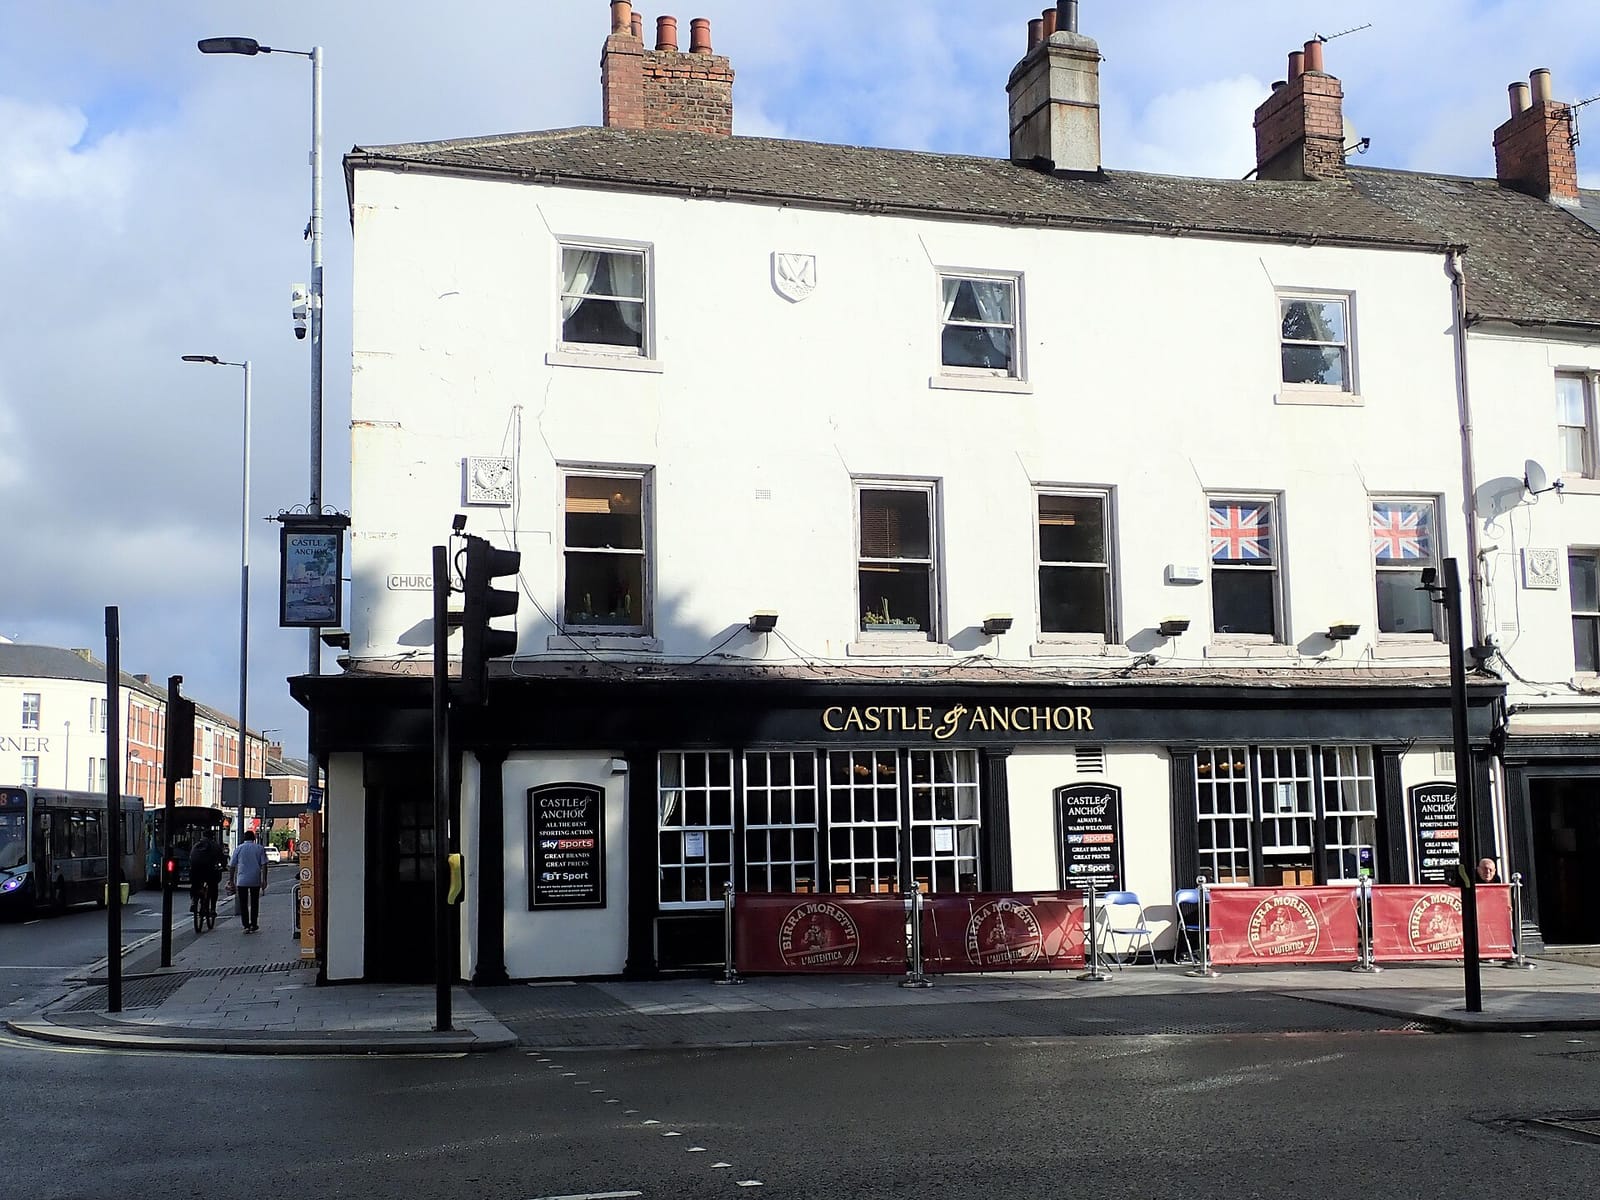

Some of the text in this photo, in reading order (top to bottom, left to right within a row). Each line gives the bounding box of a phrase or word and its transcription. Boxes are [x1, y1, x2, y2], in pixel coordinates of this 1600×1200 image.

[391, 576, 433, 587] CHURC
[823, 703, 1094, 740] CASTLE & ANCHOR
[540, 798, 580, 808] CASTLE
[1067, 796, 1101, 805] CASTLE
[1420, 794, 1451, 803] CASTLE
[1068, 806, 1106, 816] ANCHOR
[1421, 803, 1455, 813] ANCHOR
[541, 810, 584, 819] ANCHOR
[541, 839, 592, 849] sky sports
[1067, 834, 1113, 844] sky sports
[1439, 858, 1460, 867] Sport
[1087, 863, 1111, 873] Sport
[562, 872, 589, 882] Sport
[1251, 896, 1317, 943] BIRRA MORETTI
[1411, 900, 1431, 939] BIRRA
[782, 903, 857, 952] BIRRA MORETTI
[968, 902, 1040, 951] BIRRA MORETTI
[1268, 941, 1306, 956] L'AUTENTICA
[1427, 937, 1462, 953] L'AUTENTICA
[801, 951, 842, 966] L'AUTENTICA
